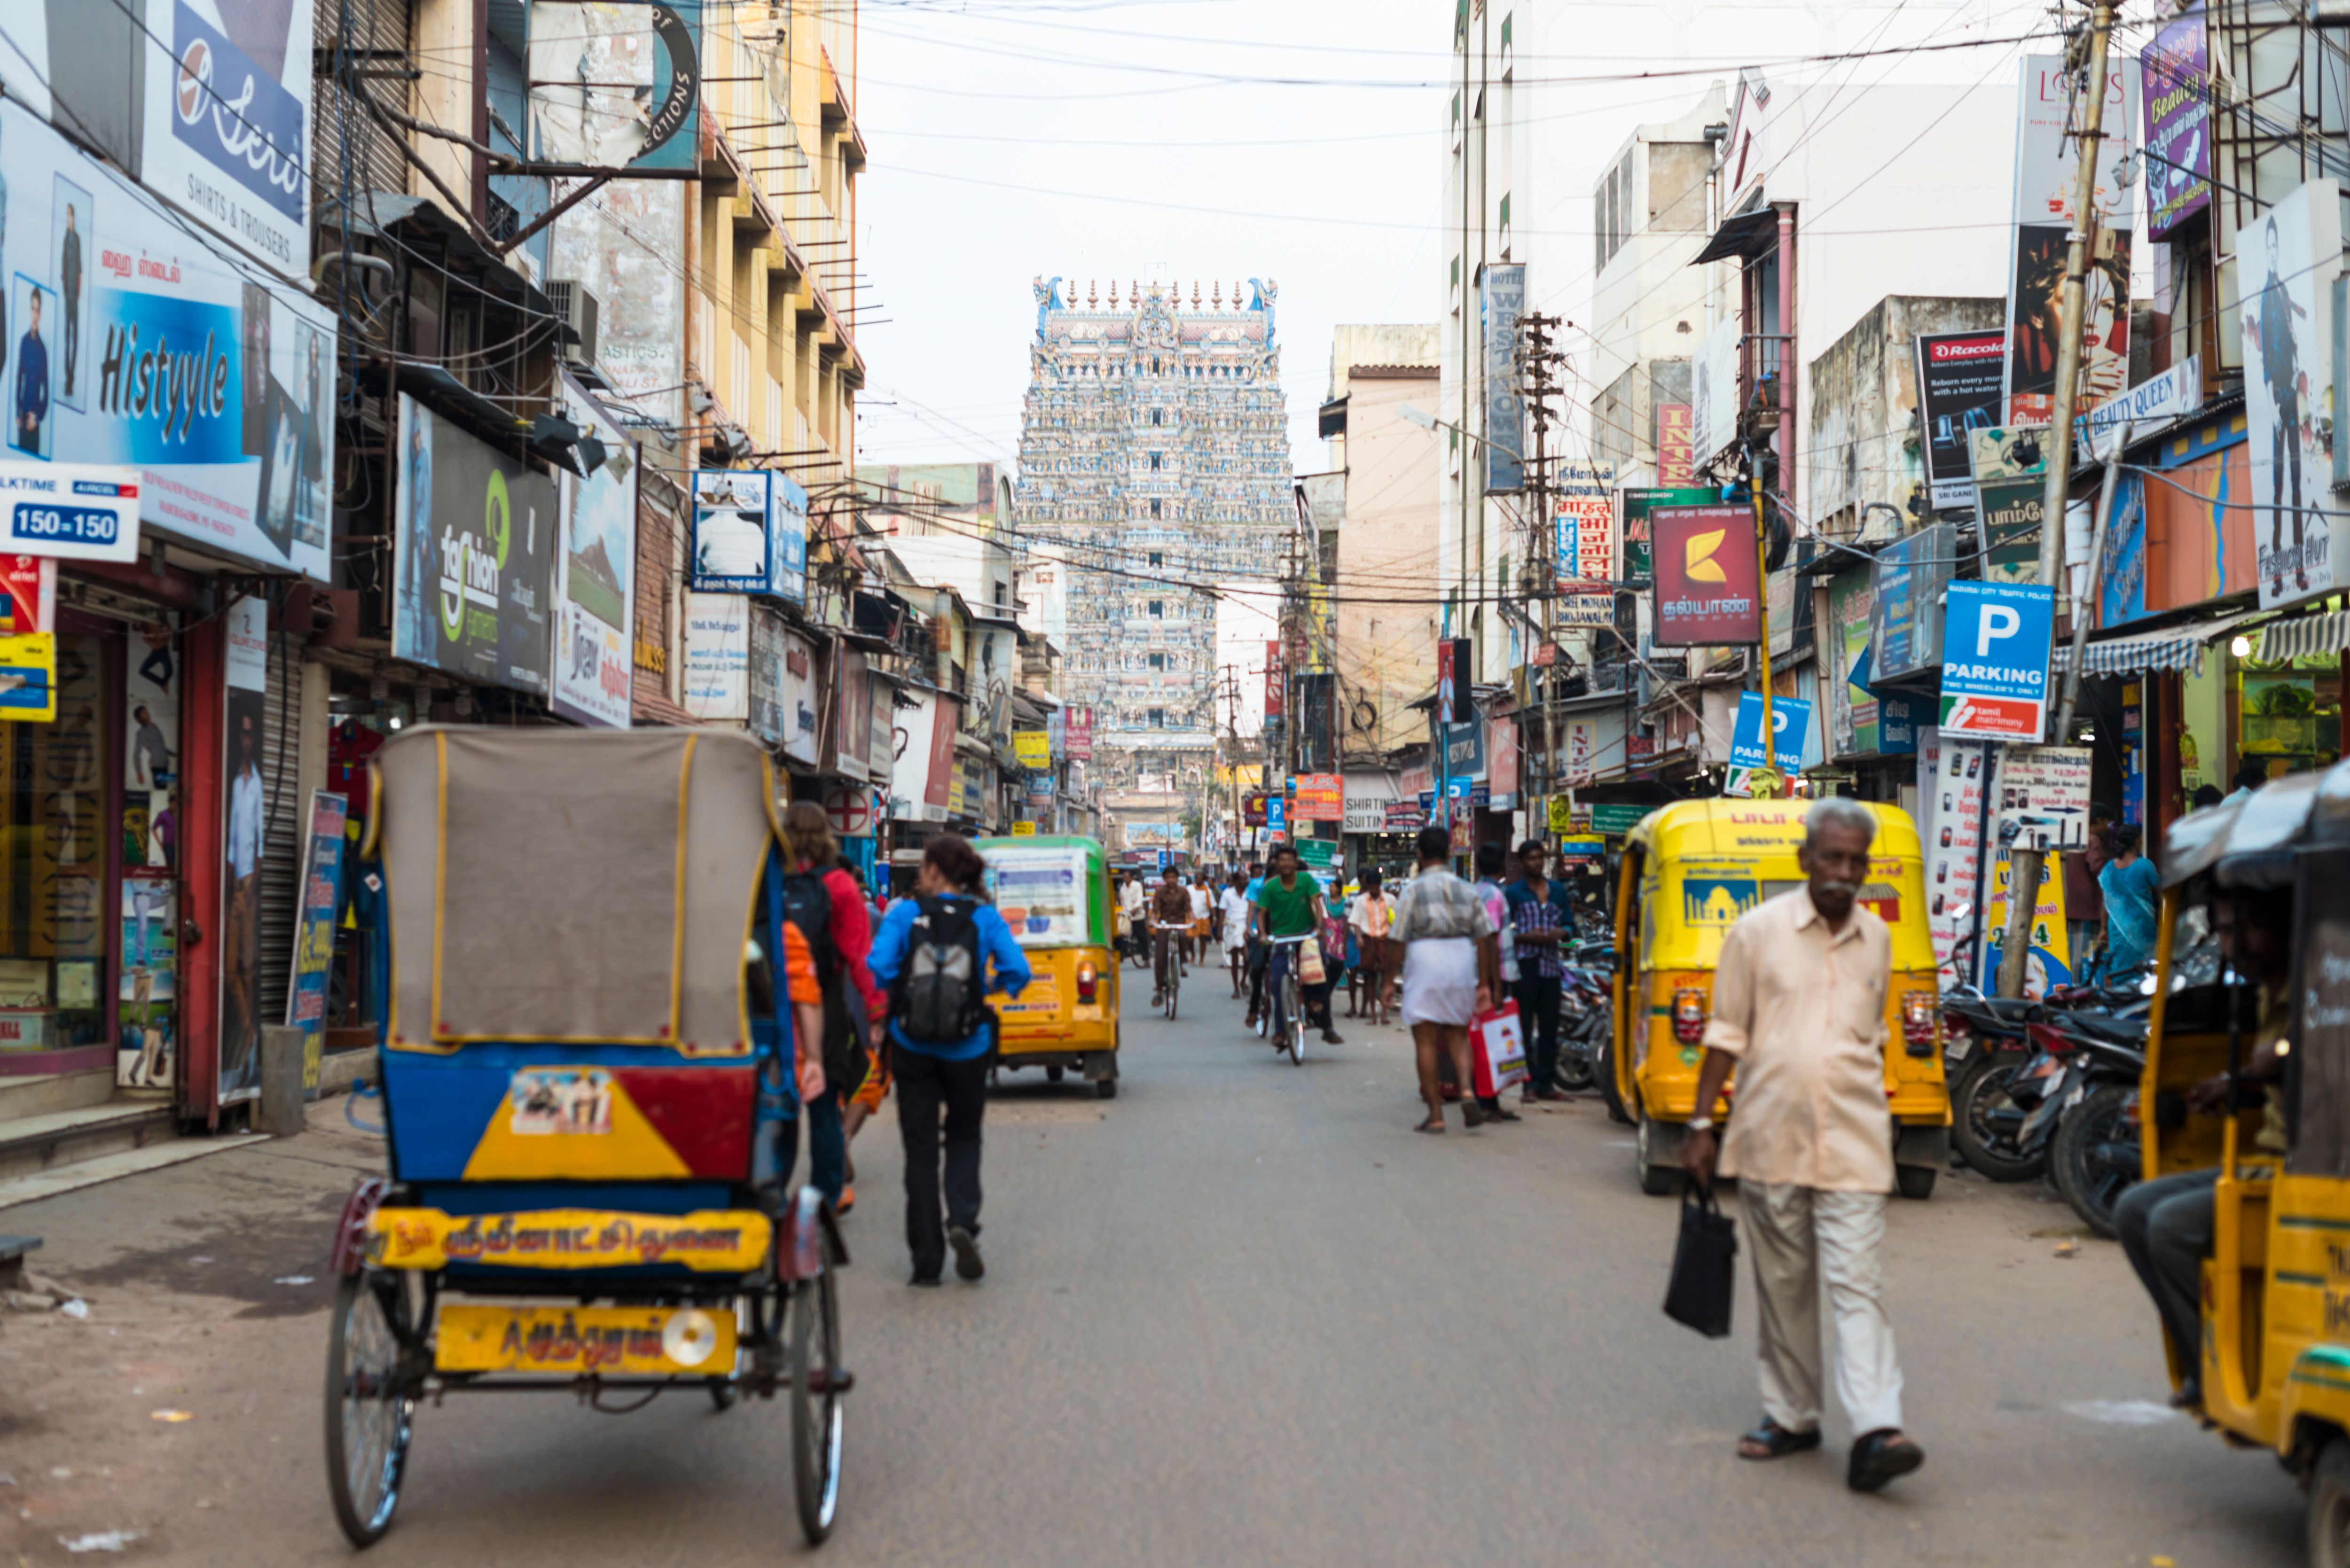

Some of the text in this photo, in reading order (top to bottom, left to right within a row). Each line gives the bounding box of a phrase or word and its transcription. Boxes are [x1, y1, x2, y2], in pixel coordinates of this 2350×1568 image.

[2151, 73, 2200, 125] Beauty
[188, 174, 291, 263] SHIRTS & TROUSERS
[1491, 272, 1524, 285] HOTEL
[1950, 342, 2005, 356] Racold
[100, 321, 228, 445] Histyyle
[1931, 378, 1959, 387] Reborn
[1961, 377, 1983, 386] every
[1933, 388, 1951, 397] with
[1959, 386, 1973, 395] hot
[1974, 385, 1998, 393] water
[2093, 374, 2174, 437] BEAUTY QUEEN
[0, 478, 117, 496] LKTIME AIRCEL
[2306, 535, 2329, 564] HUT
[1582, 597, 1612, 609] MOHAN
[1976, 604, 2021, 656] P
[1944, 663, 2042, 685] PARKING
[1977, 707, 2001, 717] tamil
[1757, 710, 1788, 744] P
[1976, 716, 2023, 727] matrimony
[1734, 746, 1799, 764] PARING
